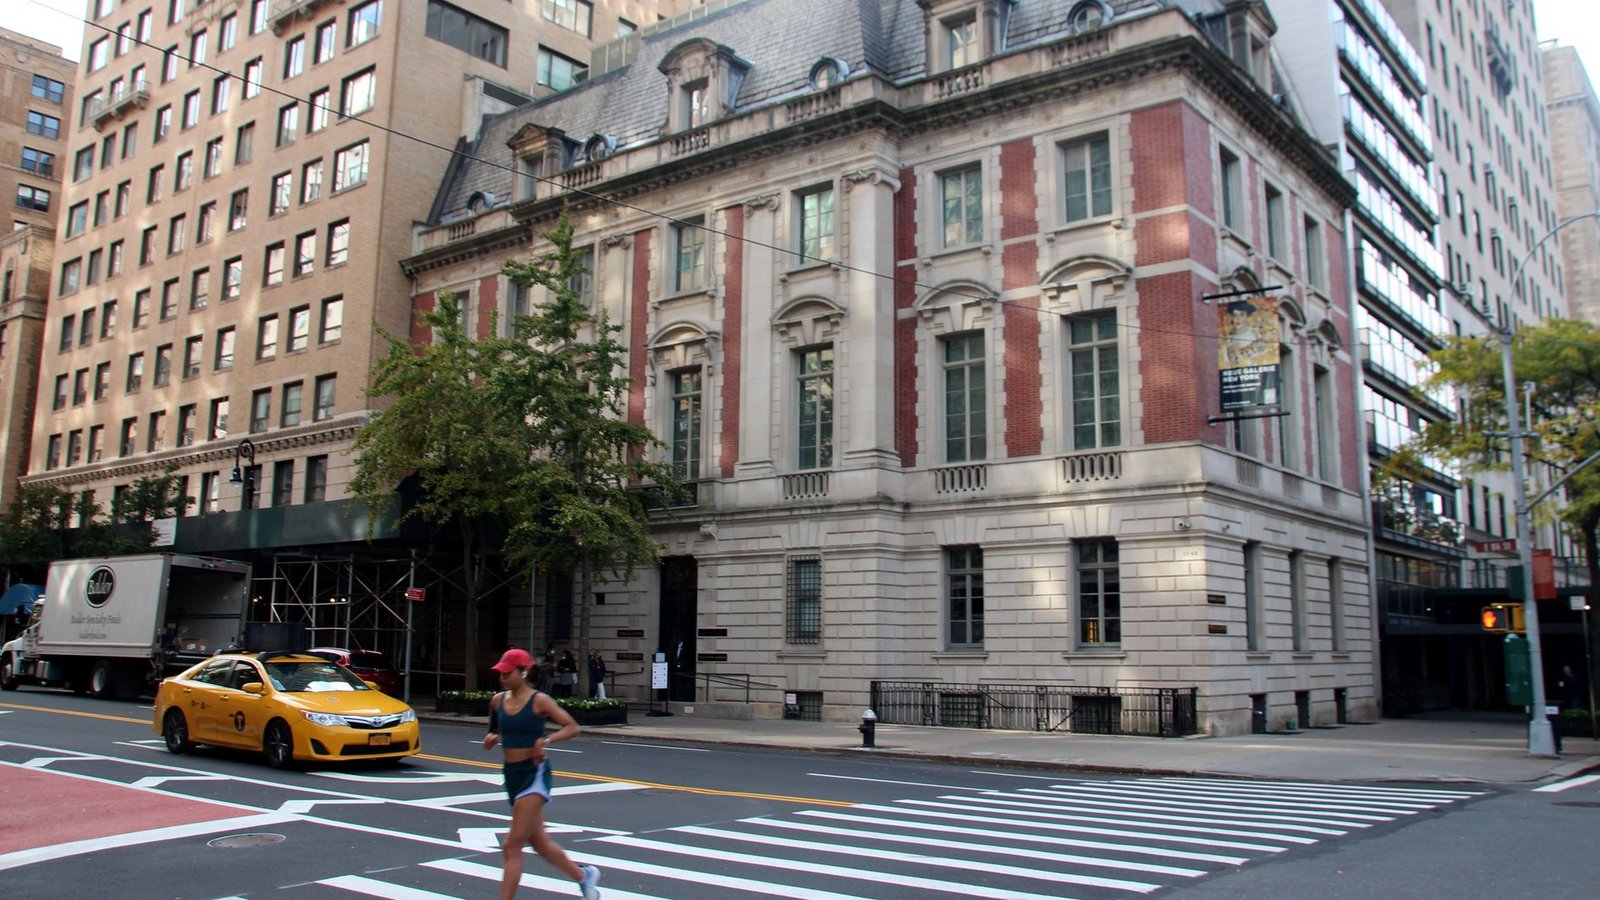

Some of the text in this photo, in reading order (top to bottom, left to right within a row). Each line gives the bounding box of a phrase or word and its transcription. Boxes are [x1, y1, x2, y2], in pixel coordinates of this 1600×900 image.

[1223, 365, 1276, 376] NEUE GALERIE
[1240, 373, 1260, 381] YORK
